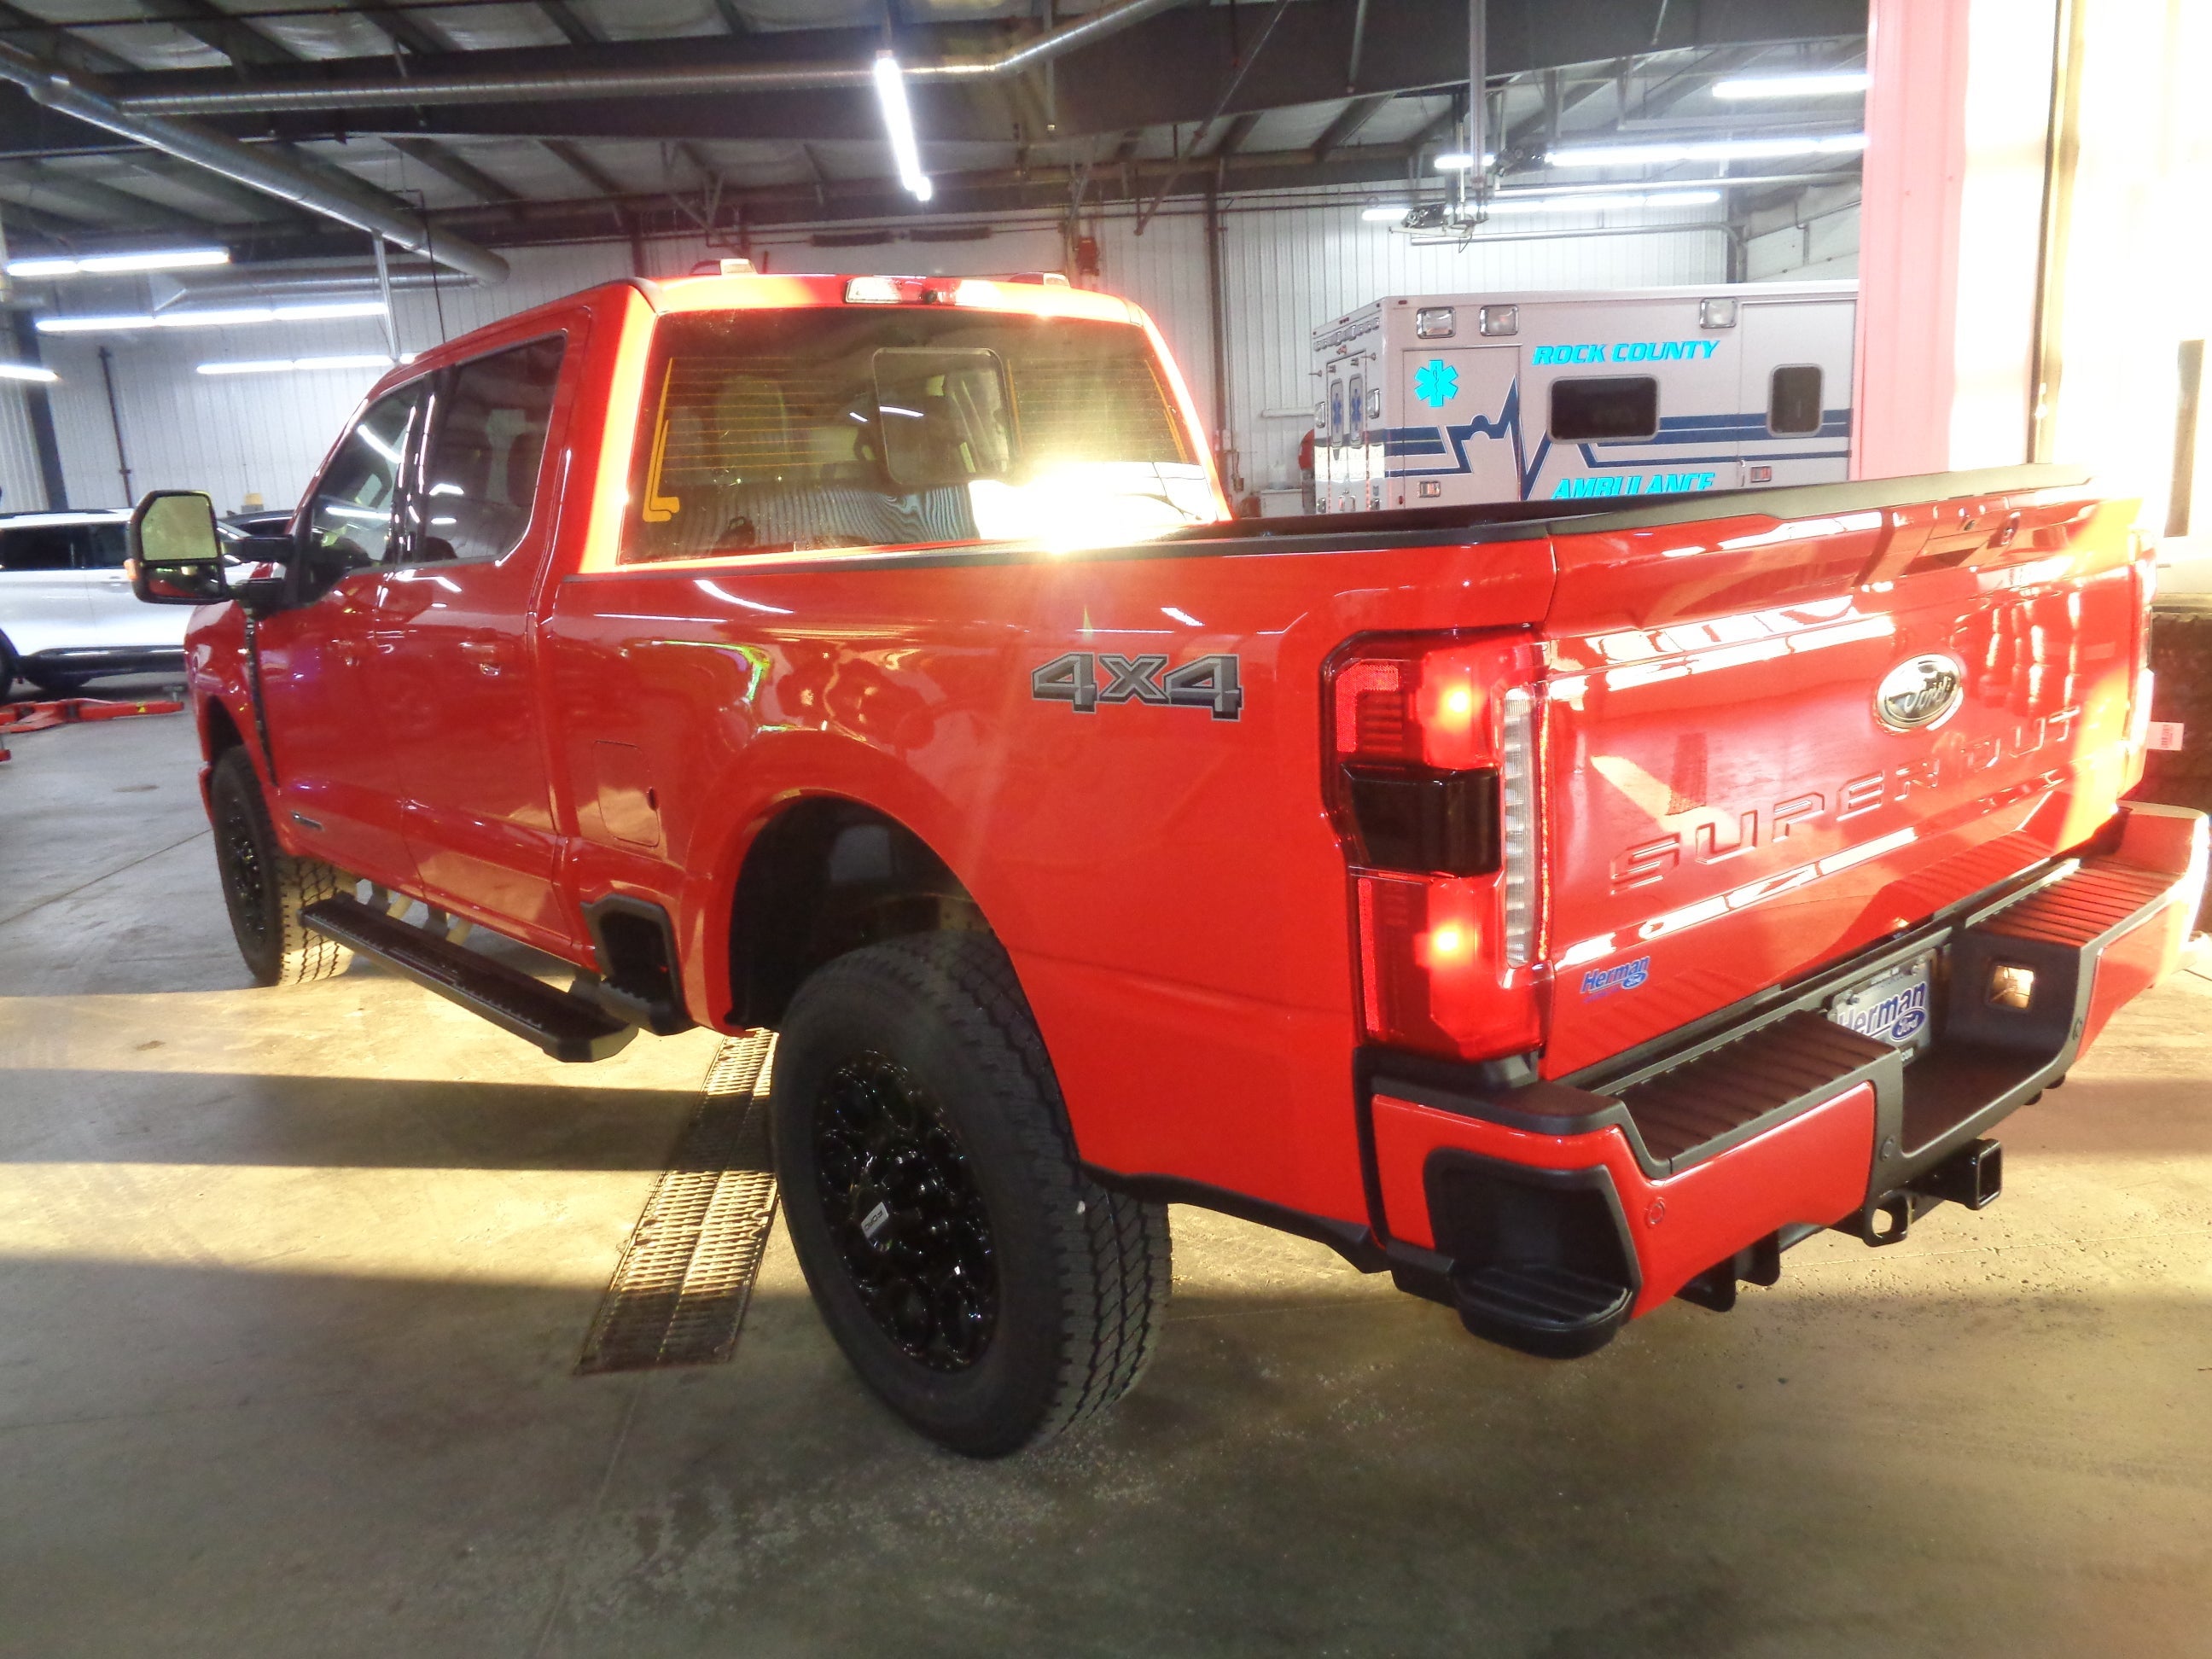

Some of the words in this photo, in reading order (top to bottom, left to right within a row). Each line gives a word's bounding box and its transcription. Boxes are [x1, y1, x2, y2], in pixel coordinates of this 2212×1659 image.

[1532, 343, 1606, 366] ROCK
[1611, 340, 1721, 363] COUNTY
[1551, 472, 1716, 501] AMBULANCE
[1610, 758, 1941, 895] SUPER
[1580, 955, 1650, 994] Herman
[1893, 1010, 1924, 1039] Ford
